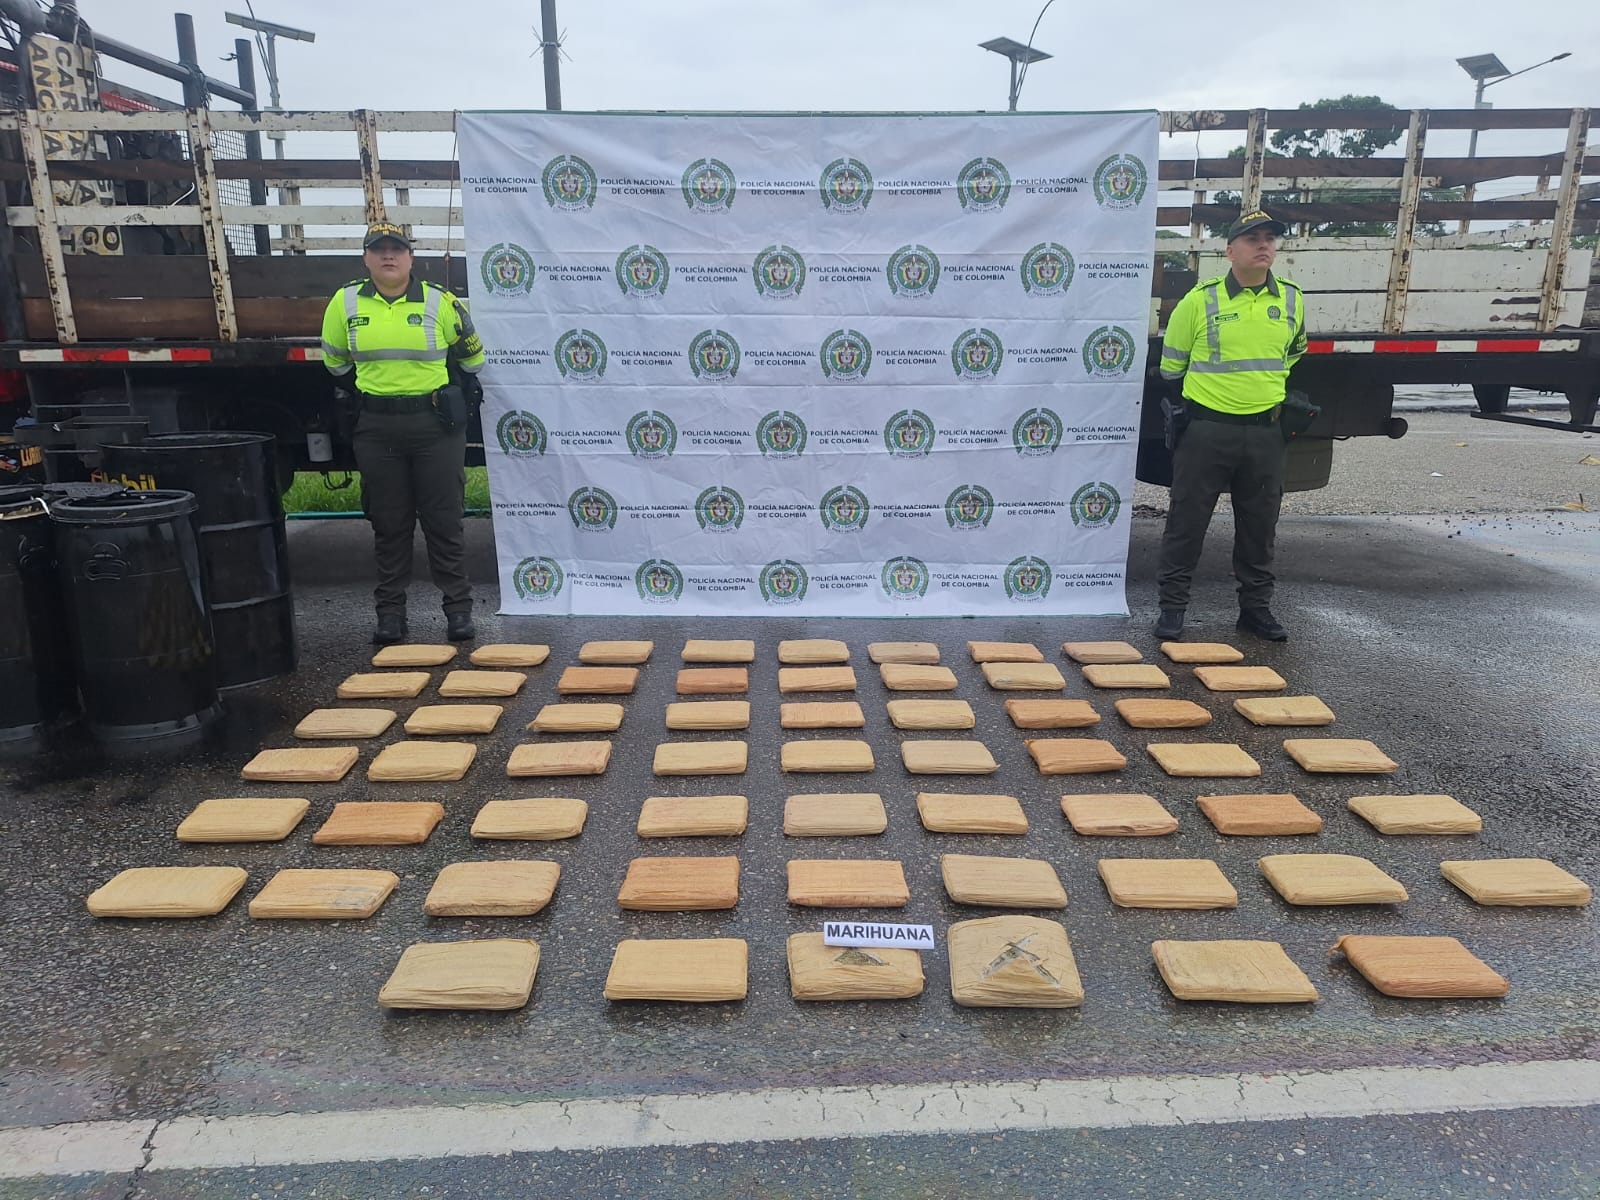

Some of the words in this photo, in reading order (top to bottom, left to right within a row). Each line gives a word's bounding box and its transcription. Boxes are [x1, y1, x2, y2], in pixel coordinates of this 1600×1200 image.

[30, 41, 63, 154] ANCA
[55, 46, 87, 155] CARA
[610, 186, 624, 195] DE
[482, 348, 508, 357] OLICÍA
[584, 580, 622, 589] COLOMBIA
[818, 581, 832, 590] DE
[940, 579, 952, 588] DE
[826, 924, 931, 940] MARIHUANA
